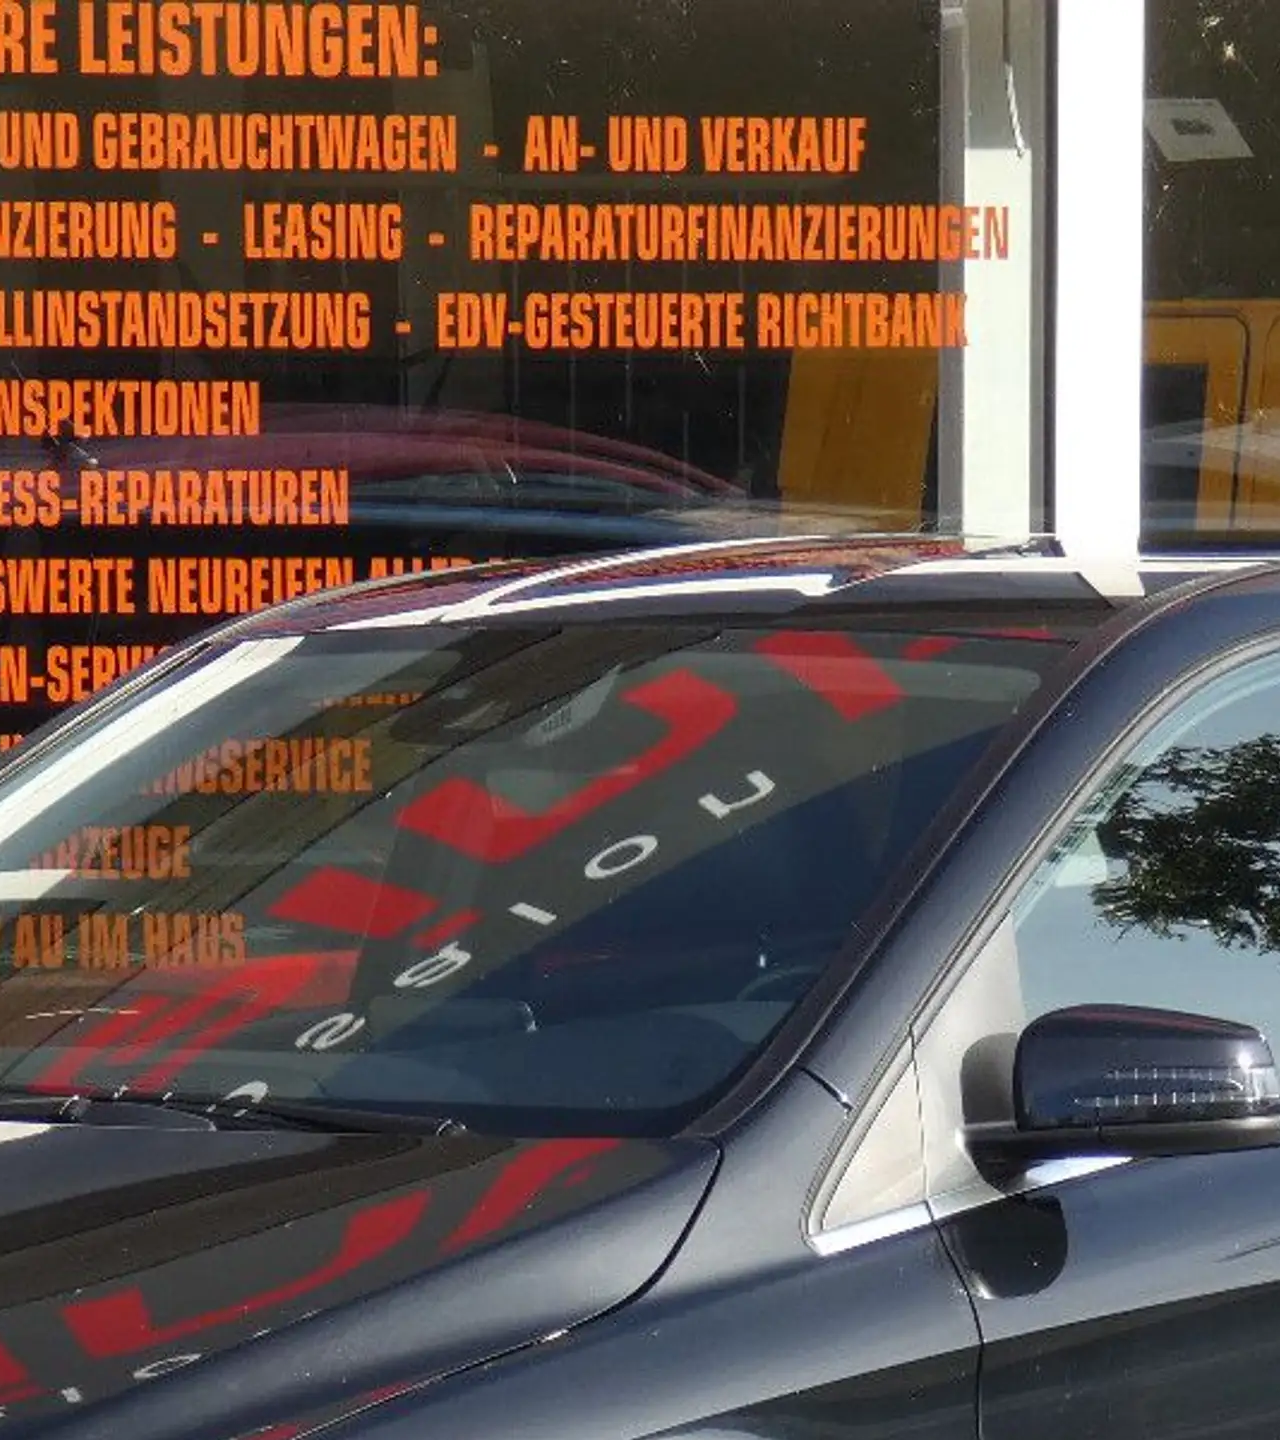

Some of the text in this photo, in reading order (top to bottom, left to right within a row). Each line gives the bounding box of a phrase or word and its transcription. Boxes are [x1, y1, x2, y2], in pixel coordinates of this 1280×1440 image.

[79, 1, 438, 78] LEISTUNGEN:
[93, 113, 457, 171] GEBRAUCHTWAGEN
[524, 115, 594, 172] AN-
[609, 116, 687, 172] UND
[702, 117, 867, 173] VERKAUF
[245, 203, 403, 260] LEASING
[470, 204, 1009, 262] REPARATURFINANZIERUNGEN
[438, 293, 744, 349] EDV-GESTEUERTE
[758, 293, 969, 349] RICHTBANK
[13, 913, 64, 970] AU
[78, 913, 129, 970] IM
[145, 911, 246, 971] HAUS
